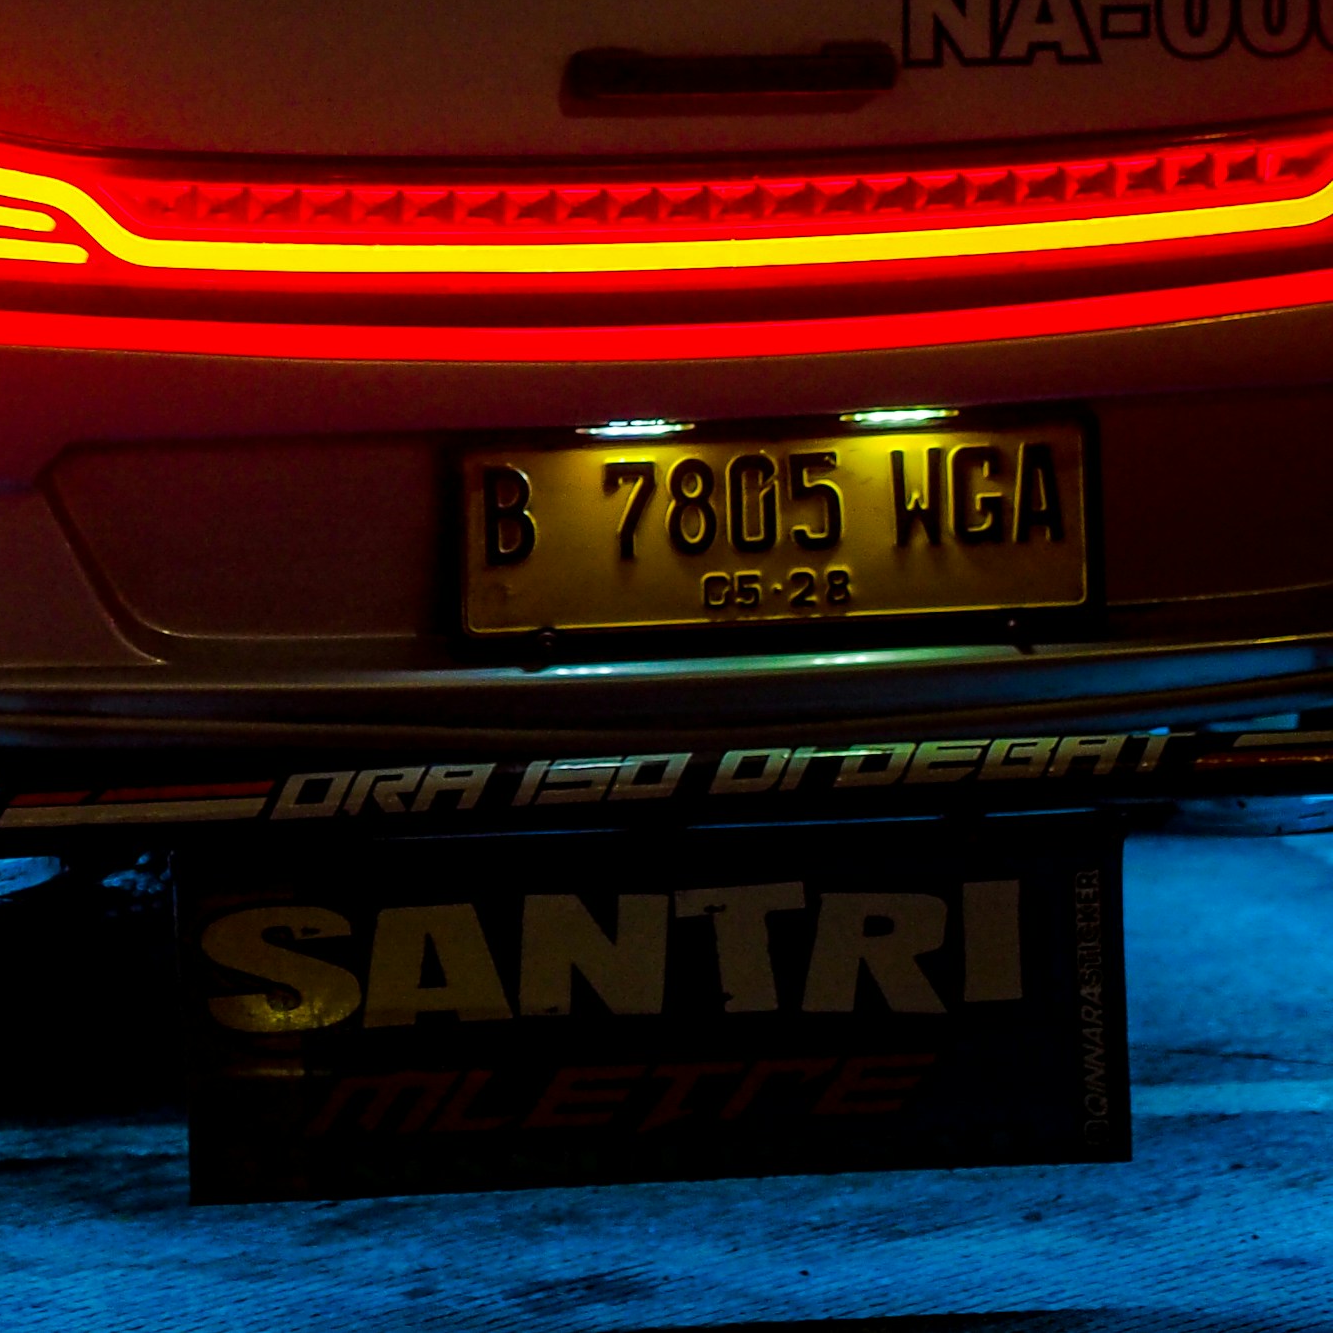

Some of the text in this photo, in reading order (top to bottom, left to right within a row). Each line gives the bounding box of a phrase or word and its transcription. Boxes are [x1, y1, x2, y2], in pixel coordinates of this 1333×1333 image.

[483, 442, 1065, 566] B 7805 WGA
[269, 762, 498, 821] ORA
[200, 876, 1023, 1034] SANTRI
